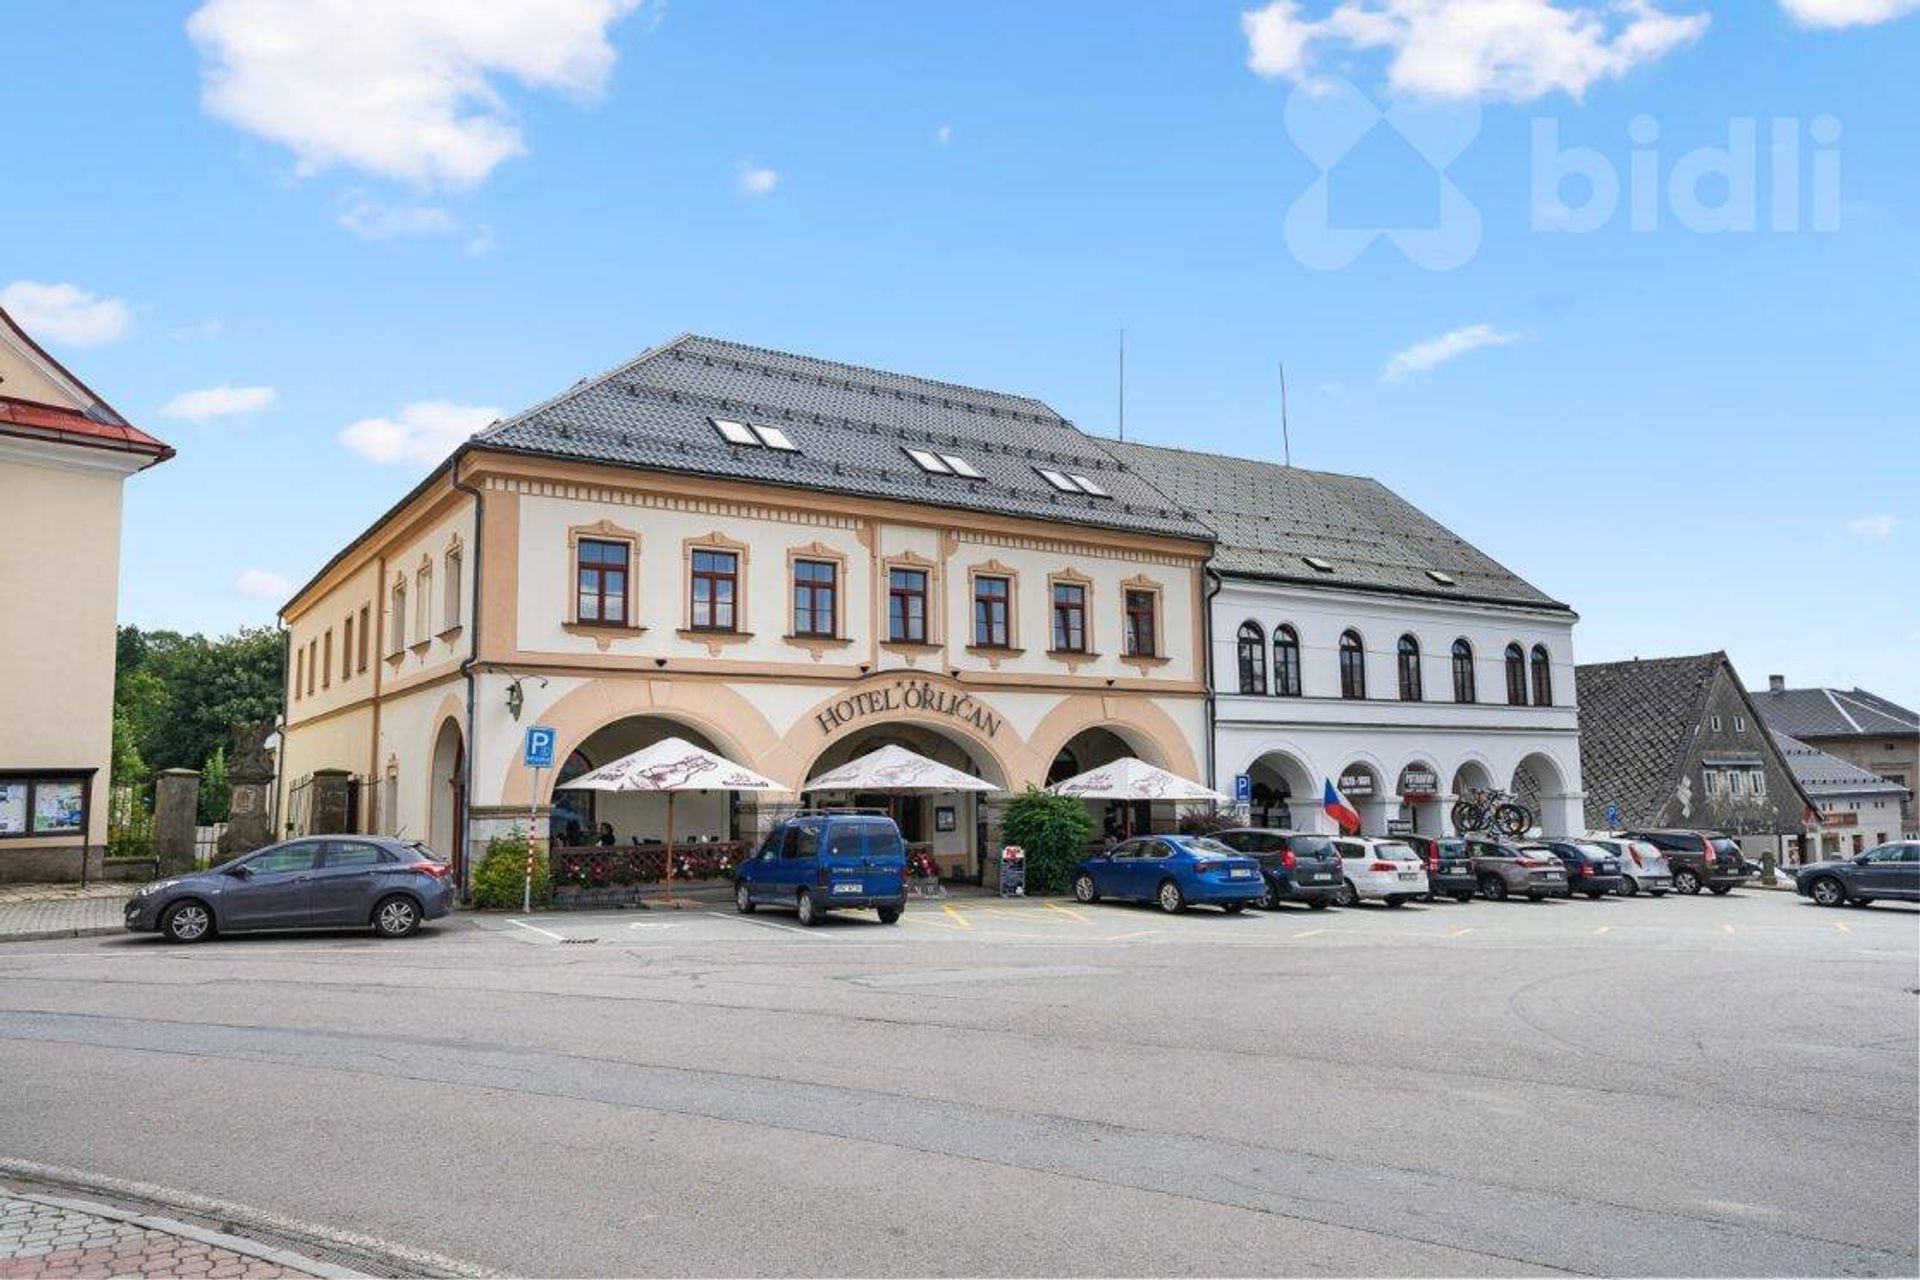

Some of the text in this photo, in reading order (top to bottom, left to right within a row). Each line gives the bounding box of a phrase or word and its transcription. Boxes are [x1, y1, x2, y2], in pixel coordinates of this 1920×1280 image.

[816, 687, 1001, 738] HOTEL ORLIČAN
[532, 731, 549, 755] P
[1238, 777, 1247, 795] P
